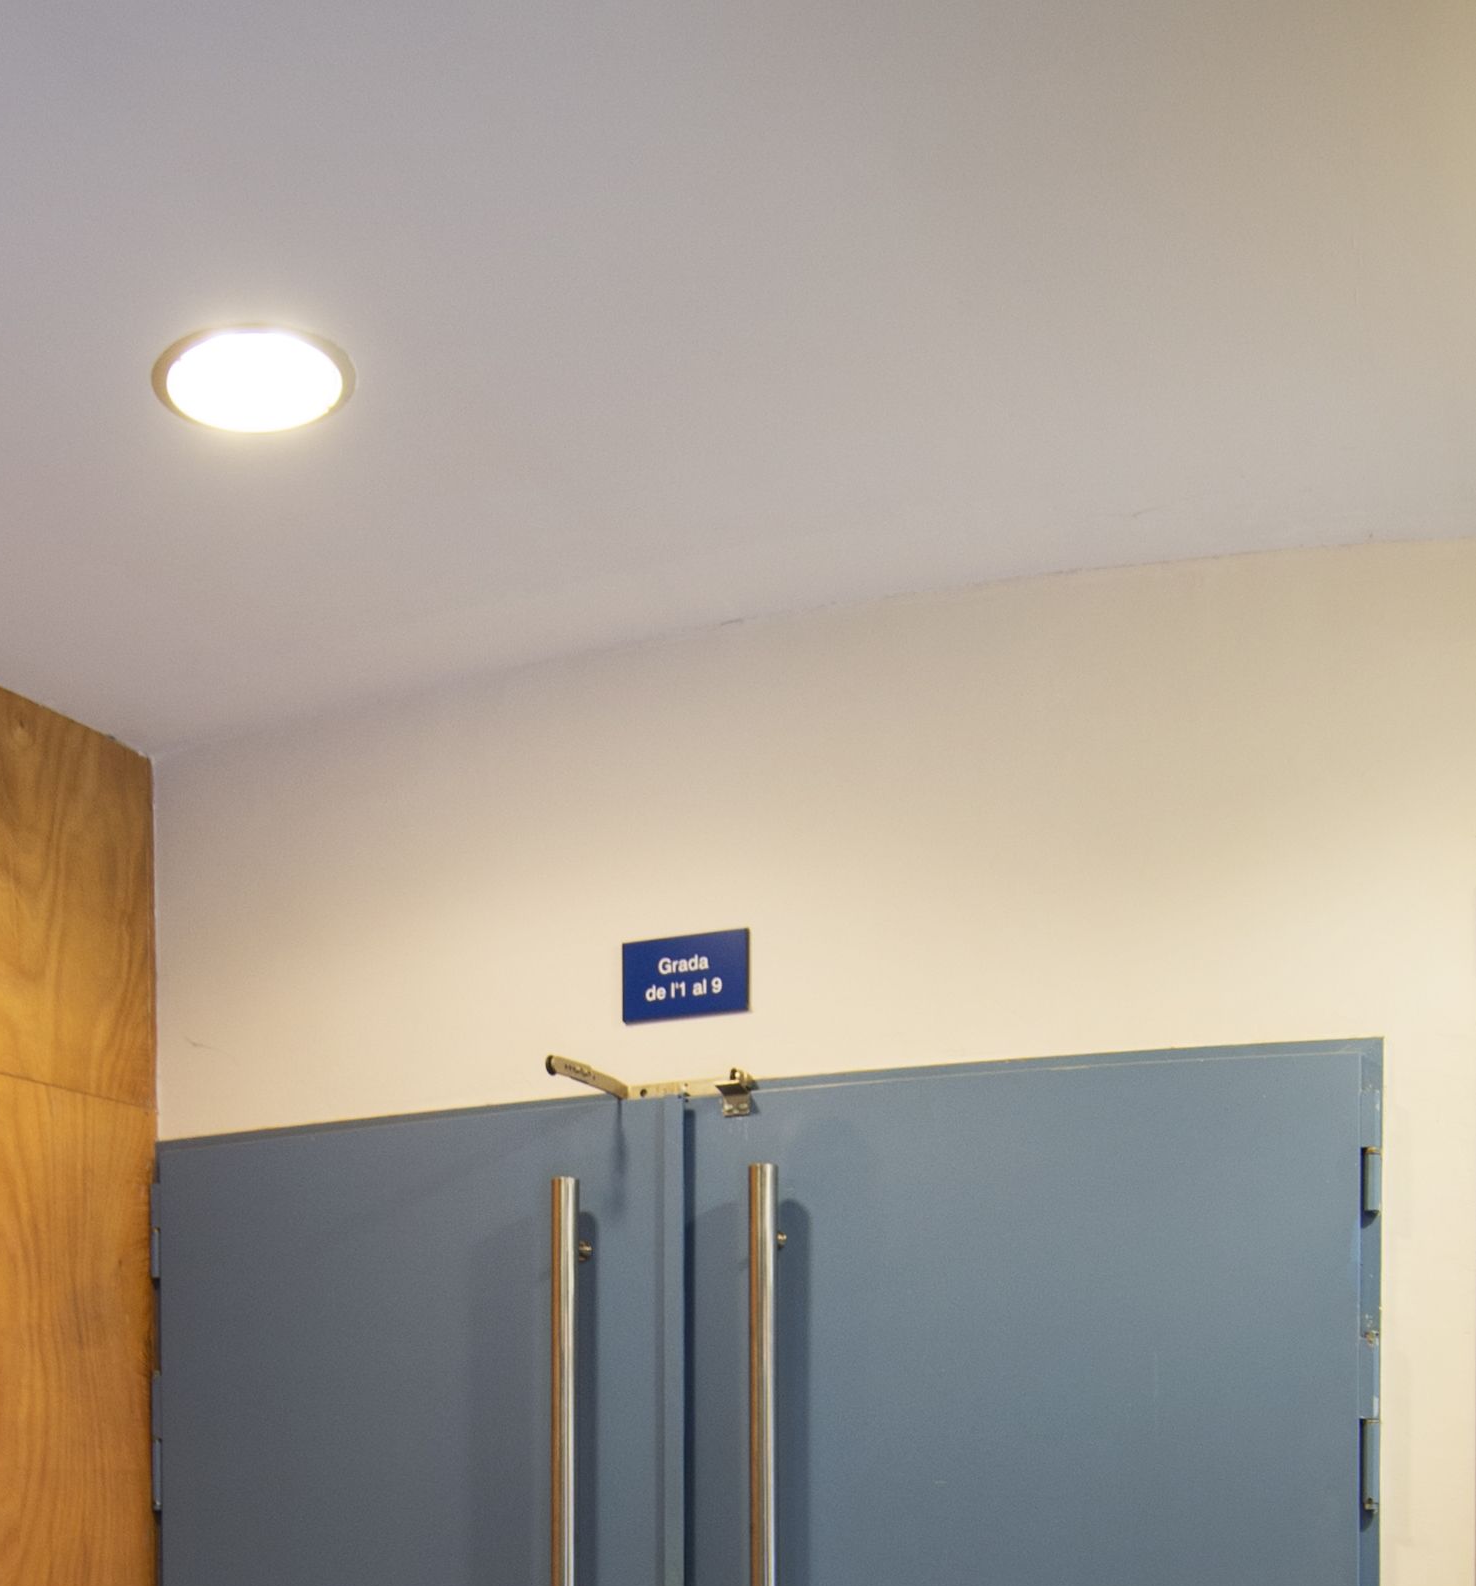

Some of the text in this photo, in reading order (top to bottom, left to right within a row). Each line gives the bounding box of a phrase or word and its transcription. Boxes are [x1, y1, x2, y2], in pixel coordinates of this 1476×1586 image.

[657, 954, 710, 976] Grada
[645, 976, 723, 1002] de l'1 al 9
